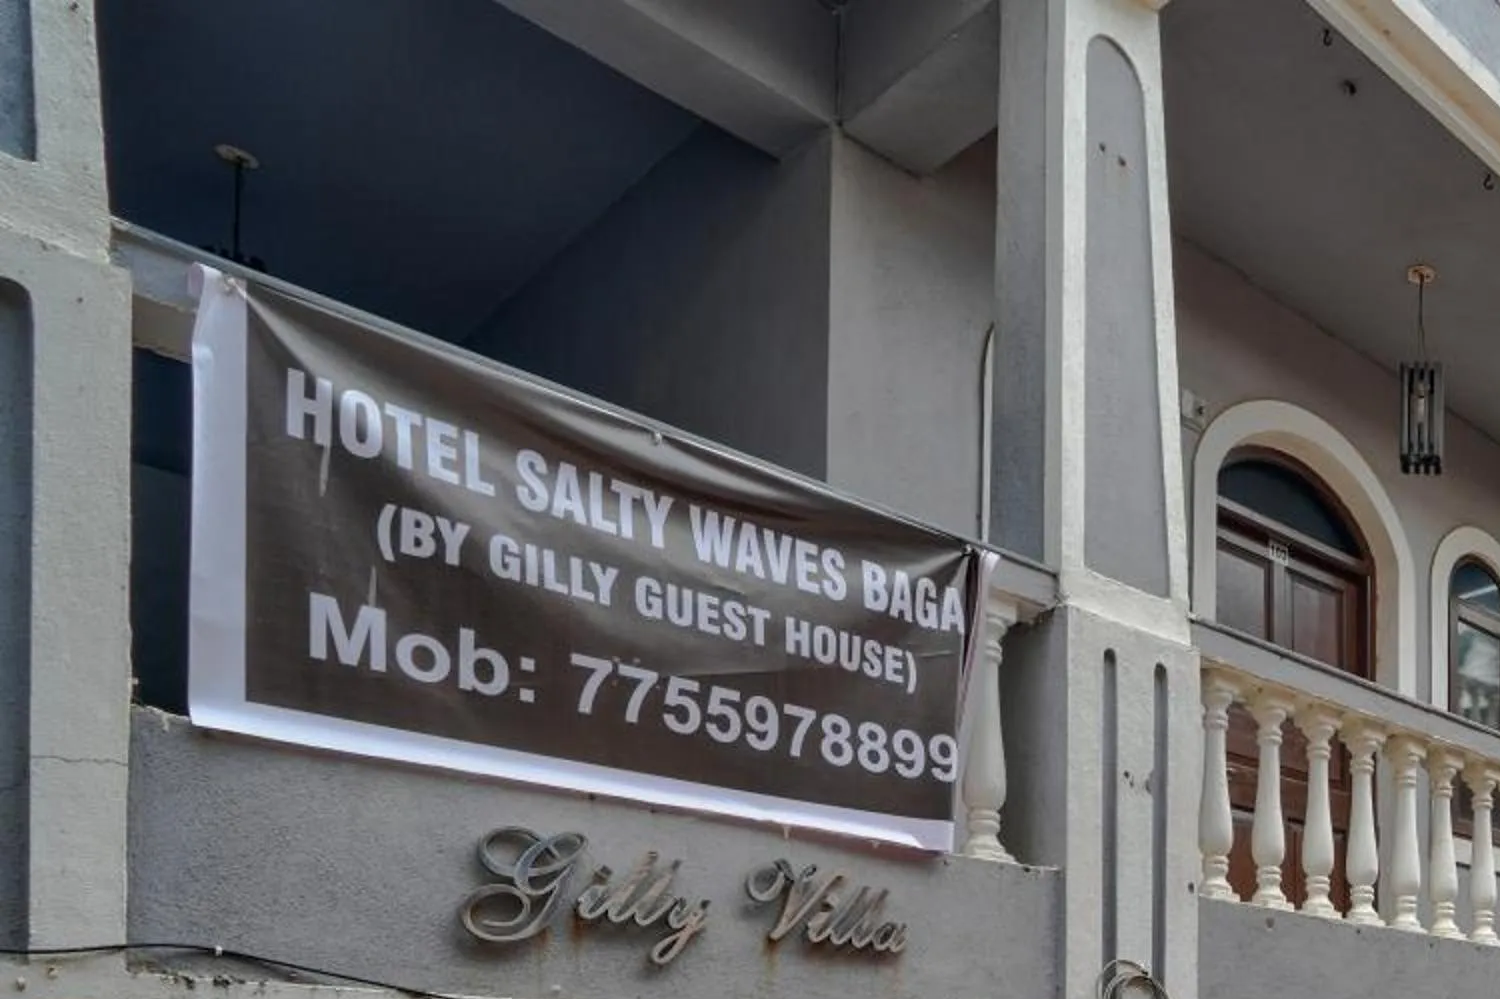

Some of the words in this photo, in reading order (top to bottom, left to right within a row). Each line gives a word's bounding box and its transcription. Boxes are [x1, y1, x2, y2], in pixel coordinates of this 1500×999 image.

[286, 368, 495, 497] HOTEL
[516, 450, 675, 551] SALTY
[689, 505, 847, 602] WAVES
[862, 559, 965, 635] BAGA
[310, 593, 537, 703] Mob:
[570, 652, 958, 783] 7755978899
[377, 504, 471, 566] (BY
[489, 534, 617, 609] GILLY
[635, 575, 771, 650] GUEST
[785, 616, 917, 694] HOUSE)
[460, 826, 710, 967] Gilly
[745, 858, 909, 954] Villa
